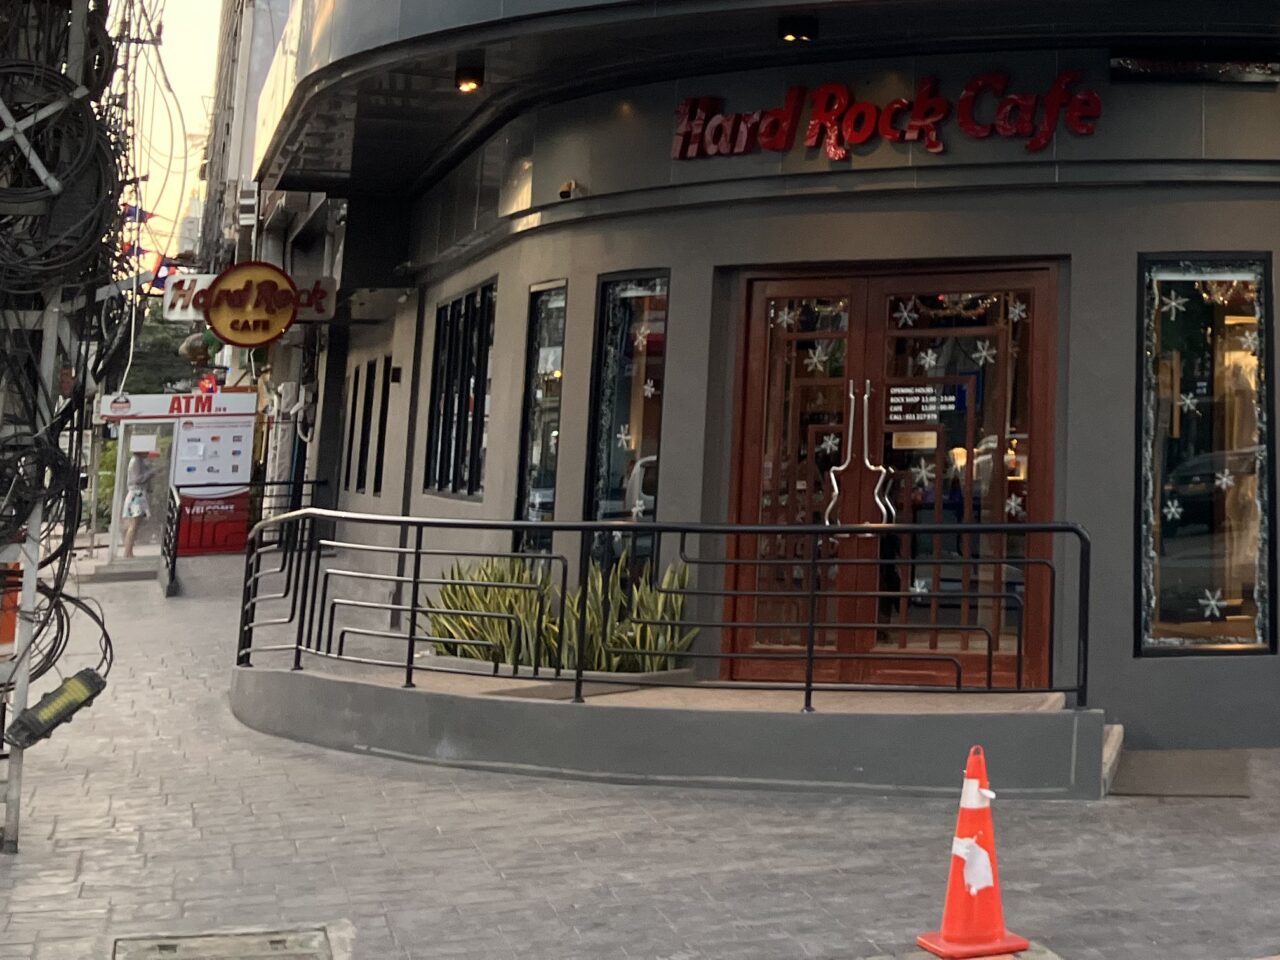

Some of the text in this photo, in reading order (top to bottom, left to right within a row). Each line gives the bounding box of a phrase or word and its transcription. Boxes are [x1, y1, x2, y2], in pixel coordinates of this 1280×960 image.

[671, 70, 1103, 161] Hard Rock Cafe
[168, 279, 329, 314] Hard Rock
[229, 319, 271, 332] CAFE
[168, 395, 213, 414] ATM
